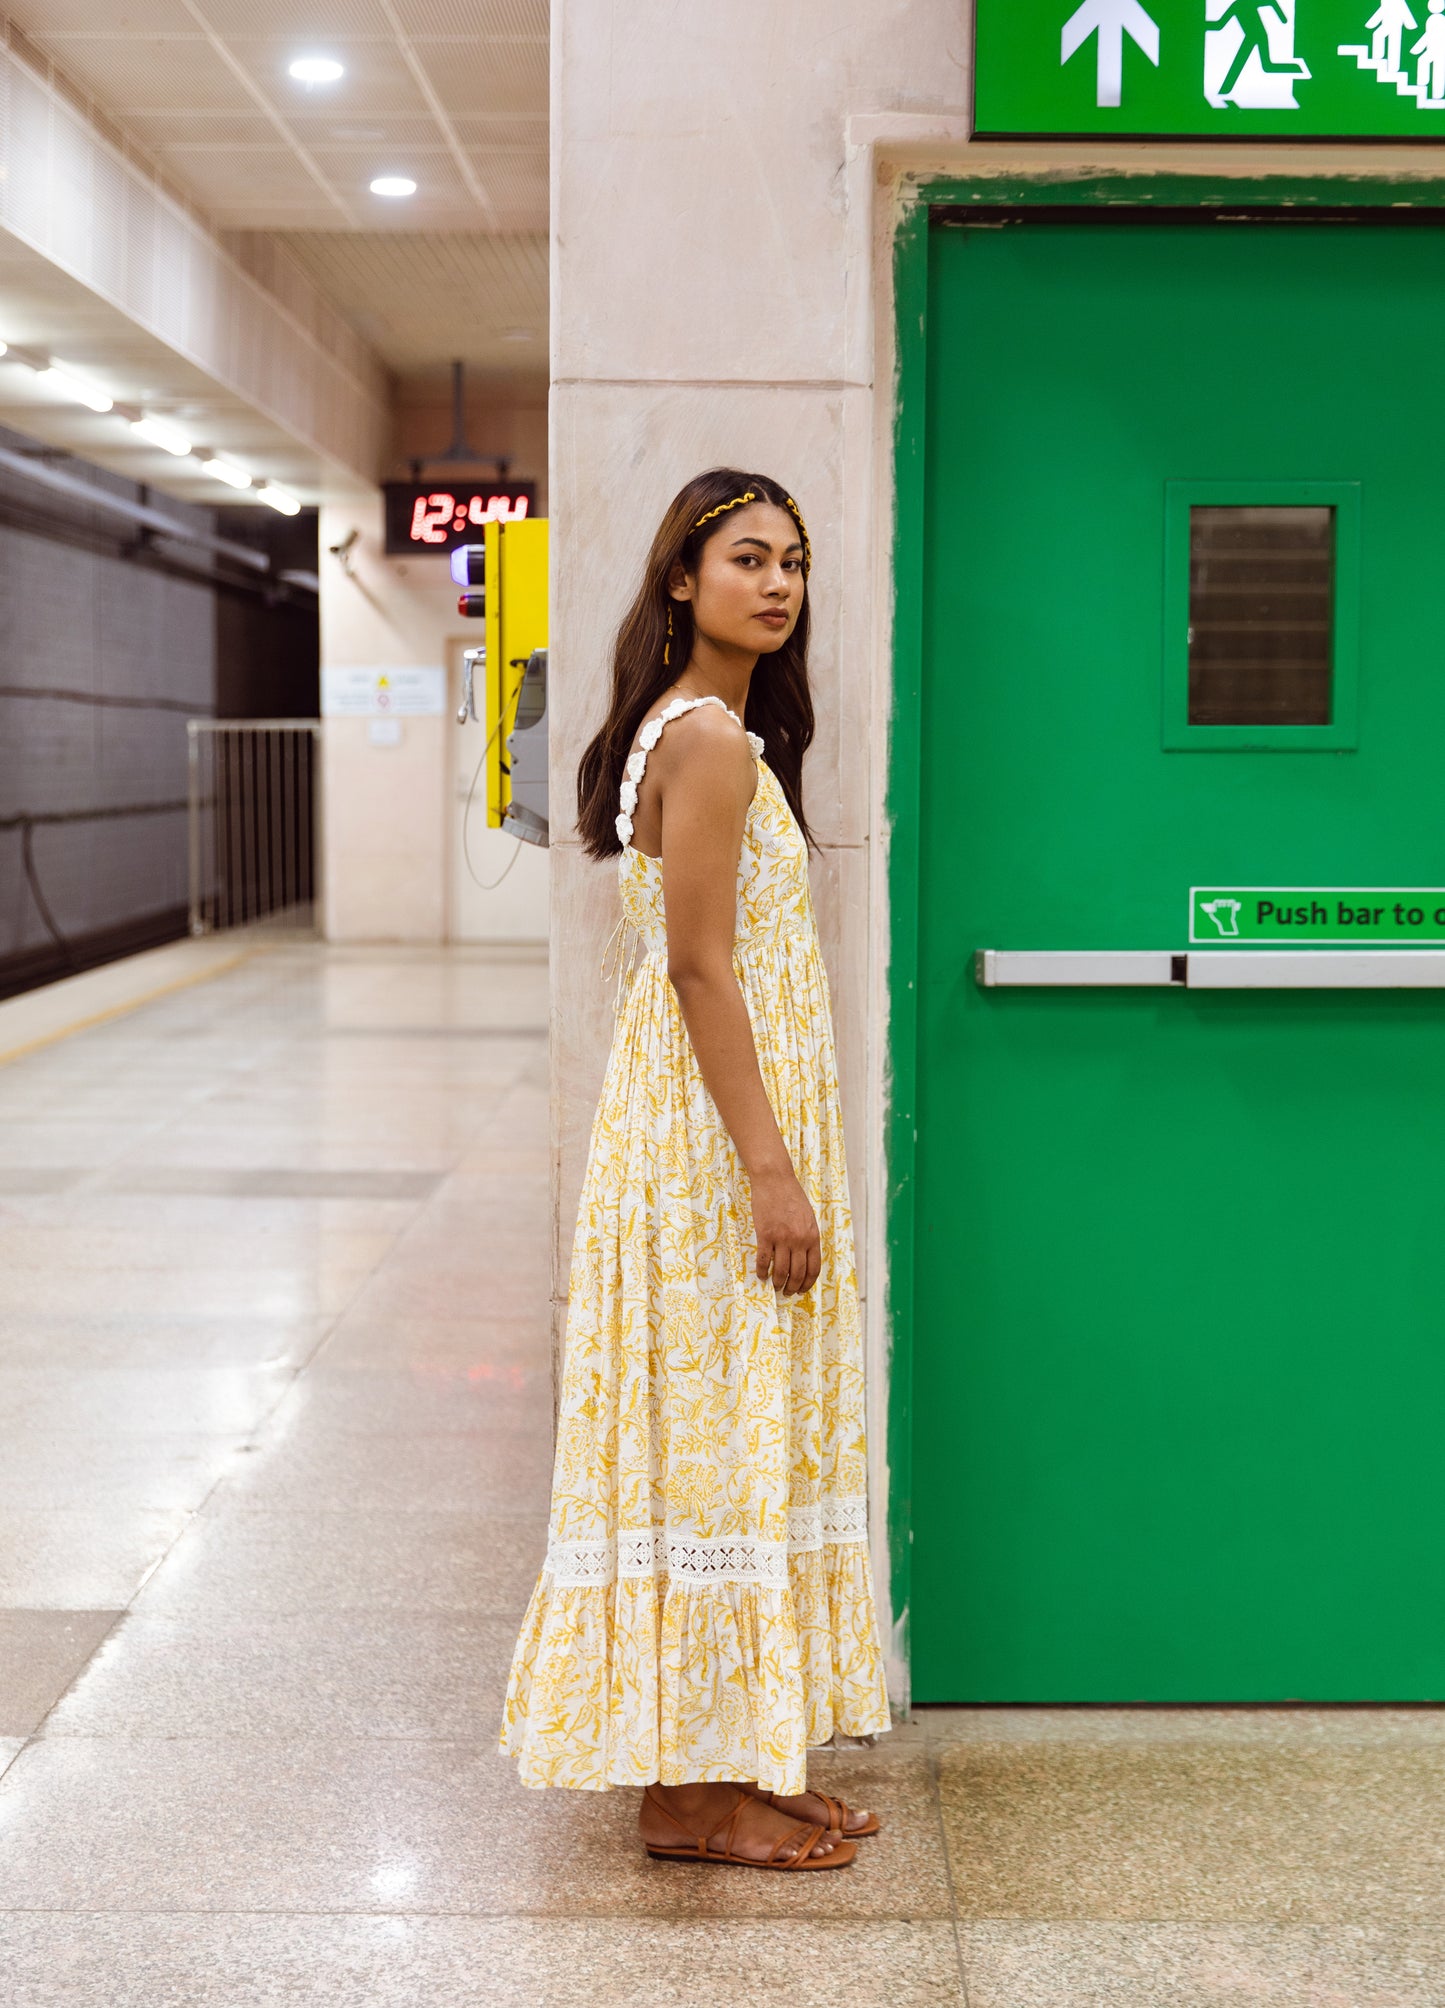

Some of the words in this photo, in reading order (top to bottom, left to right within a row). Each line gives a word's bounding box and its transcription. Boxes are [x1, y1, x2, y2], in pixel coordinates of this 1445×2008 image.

[410, 493, 528, 543] 12:44
[1257, 900, 1327, 925] Push
[1337, 901, 1384, 925] bar
[1392, 903, 1424, 925] to
